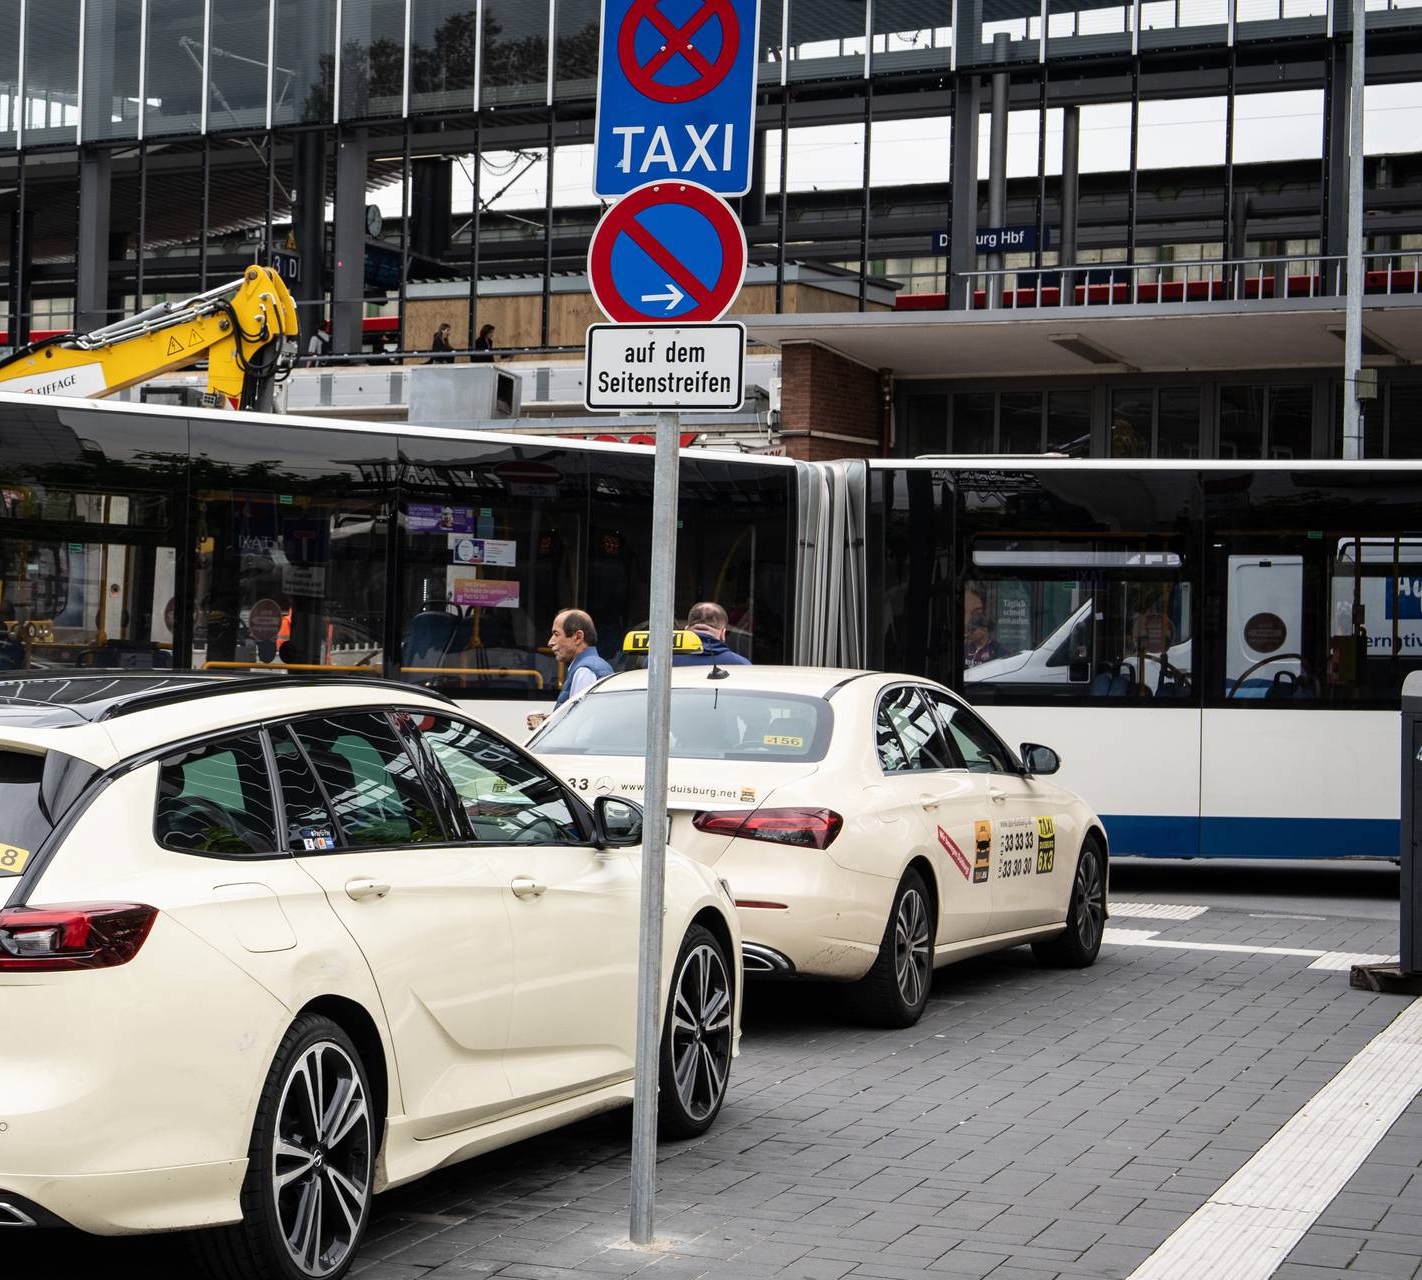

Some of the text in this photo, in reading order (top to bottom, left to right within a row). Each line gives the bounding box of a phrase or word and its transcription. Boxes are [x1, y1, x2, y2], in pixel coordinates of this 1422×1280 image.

[612, 124, 734, 173] TAXI
[939, 231, 1025, 247] Durg Hbf
[289, 258, 297, 278] D
[624, 341, 705, 363] auf dem
[598, 371, 731, 393] Seitenstreifen
[635, 633, 682, 647] TI
[1038, 818, 1054, 835] TAXI
[1005, 834, 1014, 852] 33
[1015, 832, 1024, 850] 33
[1025, 831, 1034, 849] 33
[1002, 859, 1012, 878] 33
[1012, 858, 1022, 876] 30
[1023, 857, 1032, 875] 30
